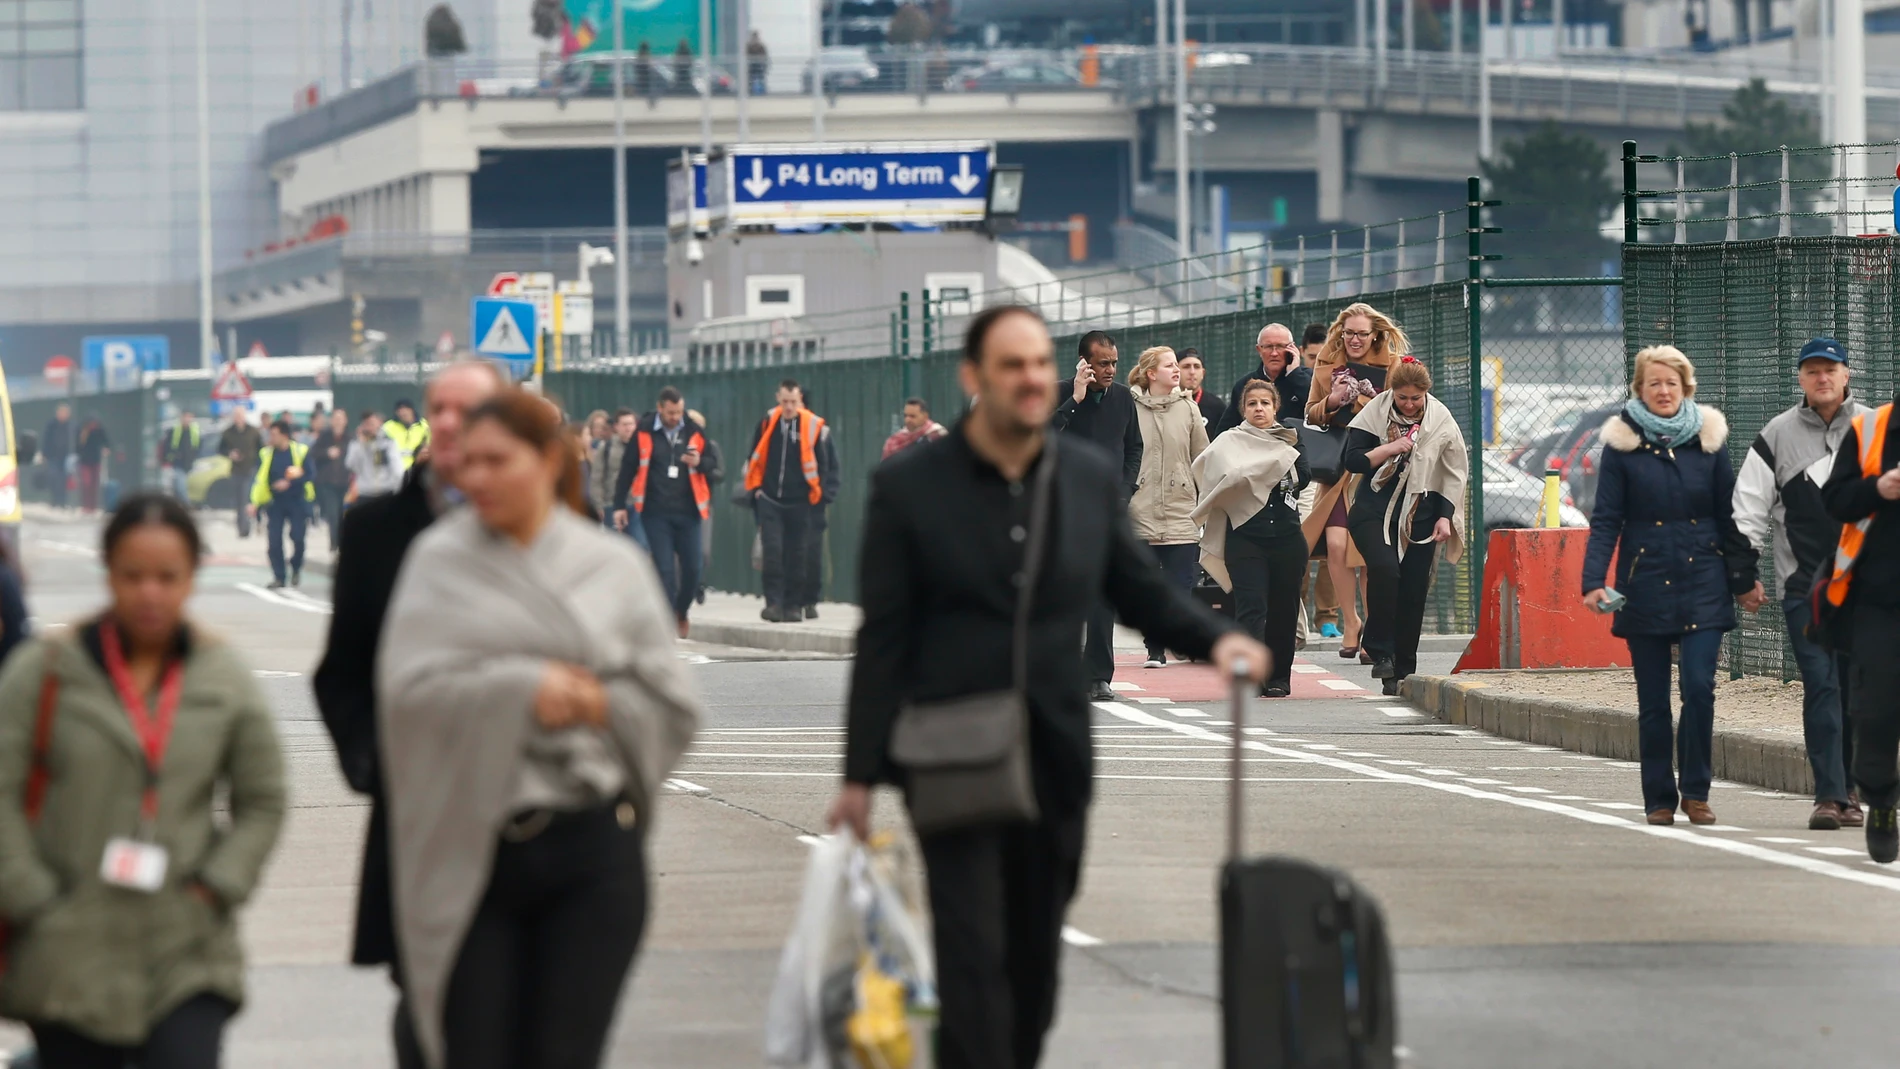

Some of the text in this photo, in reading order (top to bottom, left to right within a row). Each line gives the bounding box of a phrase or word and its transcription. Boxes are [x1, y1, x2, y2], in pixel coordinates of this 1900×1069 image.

[778, 161, 944, 191] P4 Long Term
[103, 342, 136, 392] P
